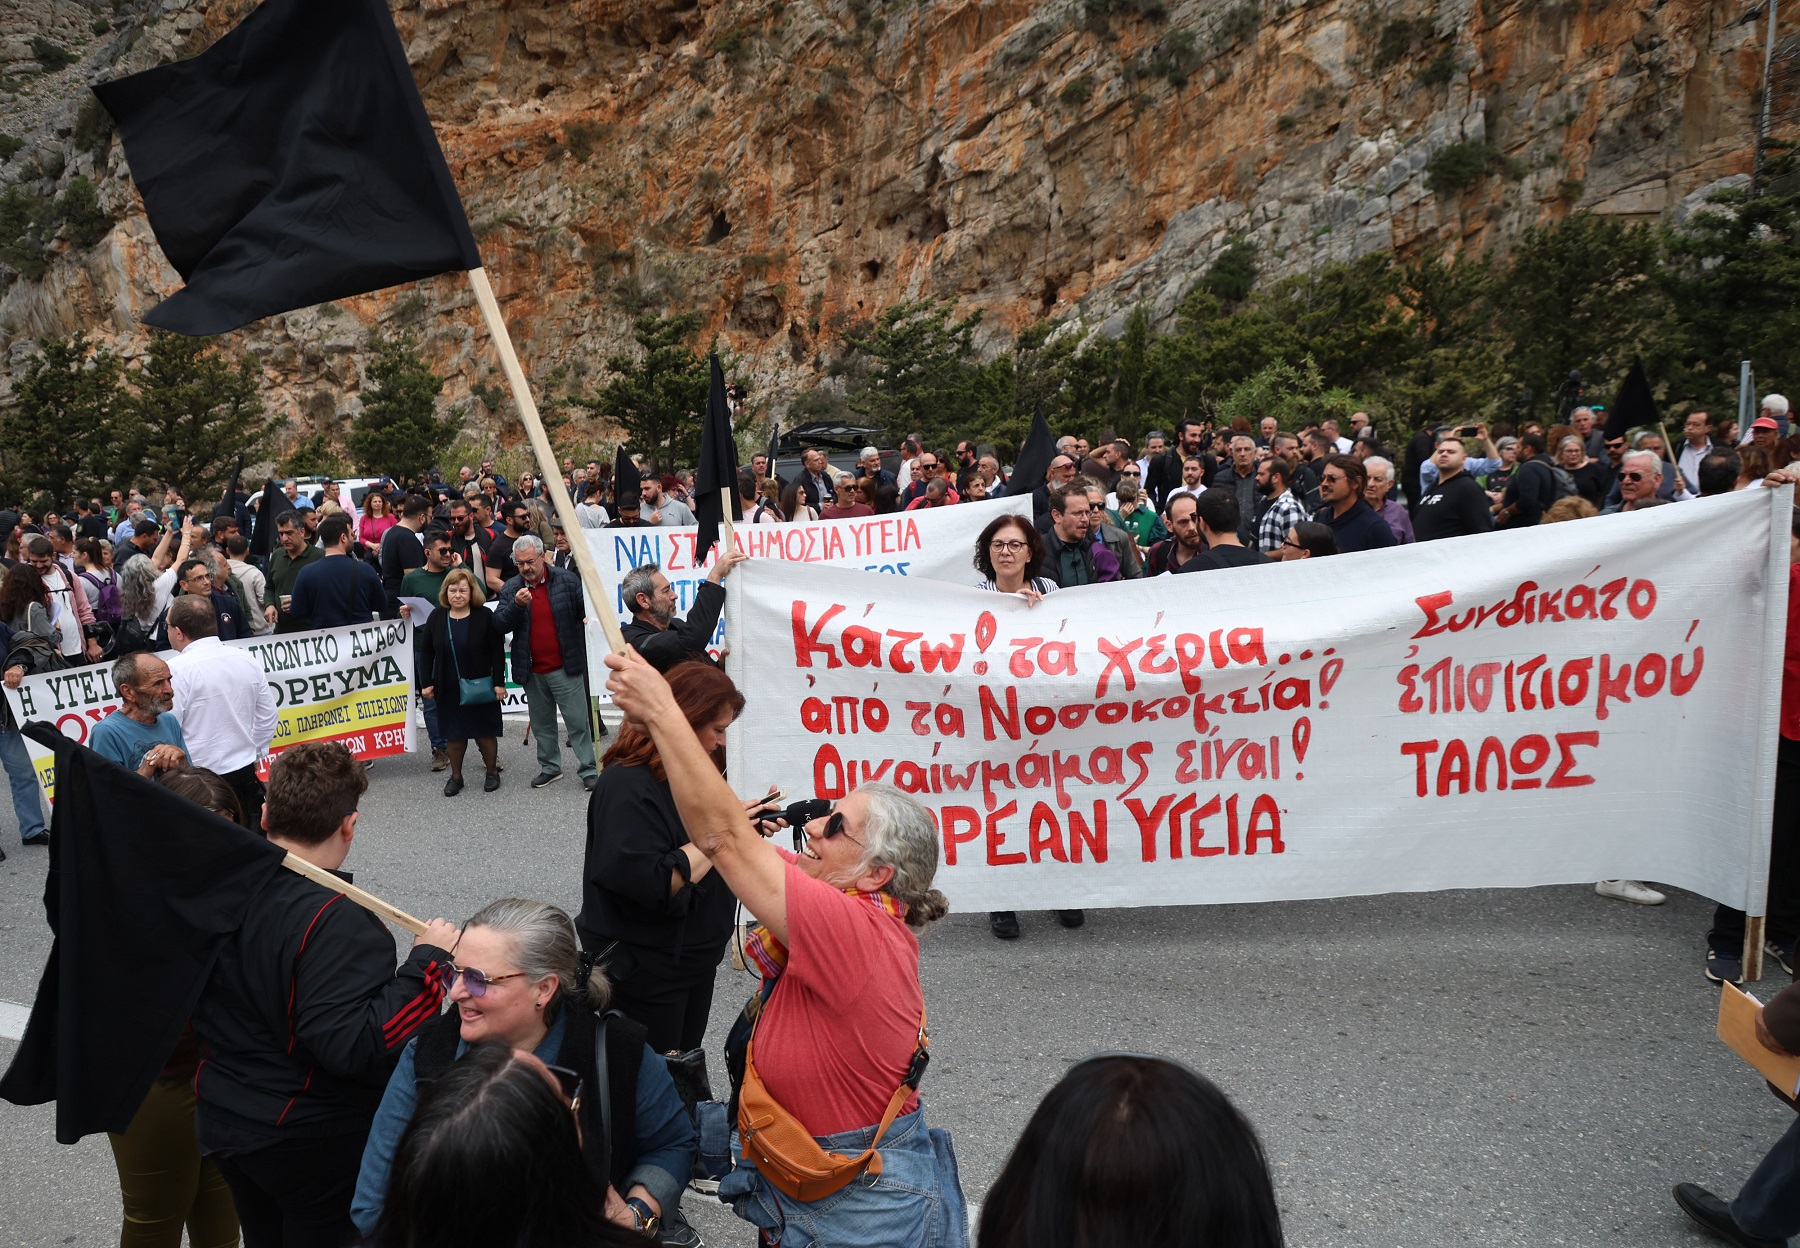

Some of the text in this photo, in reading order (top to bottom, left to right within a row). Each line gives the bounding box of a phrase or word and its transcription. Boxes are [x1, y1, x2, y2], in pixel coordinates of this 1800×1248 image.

[614, 534, 660, 571] ΝΑΙ
[848, 517, 921, 556] ΥΓΕΙΑ
[1410, 564, 1657, 640] Συνδικάτο
[1008, 617, 1078, 679] τά
[17, 685, 37, 717] Η
[46, 668, 122, 711] ΥΓΕΙ
[297, 705, 351, 734] ΠΛΗΡΩΝΕΙ
[905, 683, 965, 738] τά
[1401, 730, 1599, 798] ΤΑΛΩΣ
[922, 792, 1285, 866] ΡΕΑΝ ΥΓΕΙΑ
